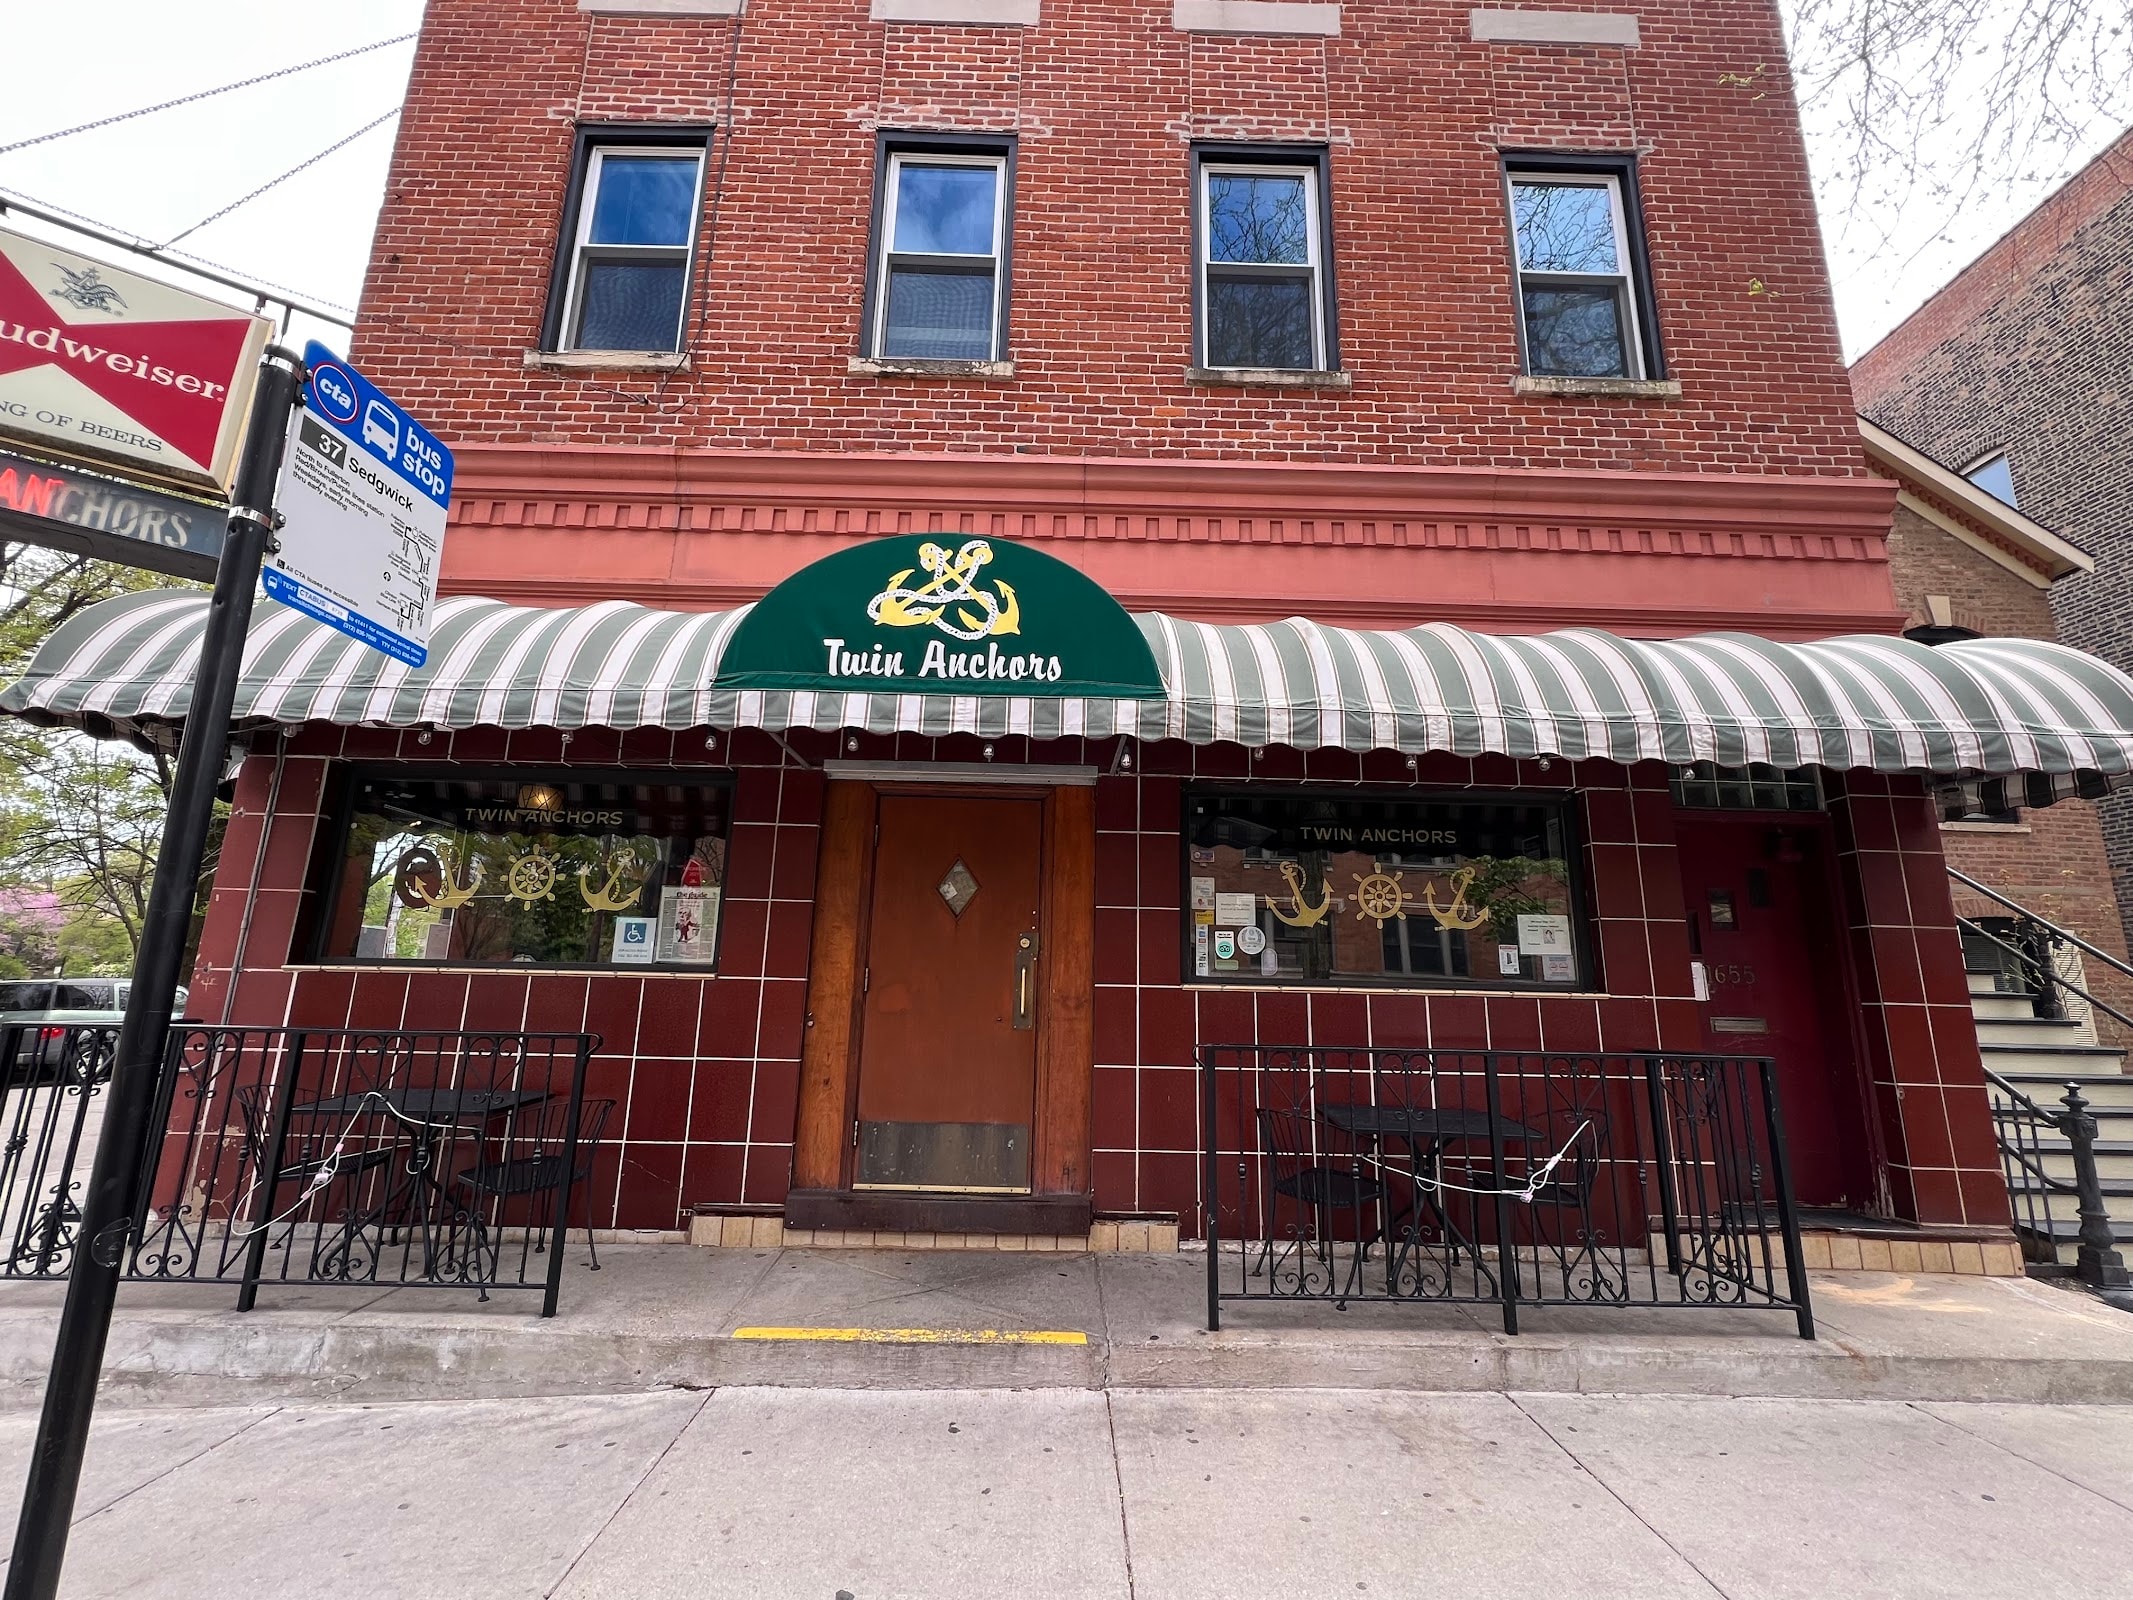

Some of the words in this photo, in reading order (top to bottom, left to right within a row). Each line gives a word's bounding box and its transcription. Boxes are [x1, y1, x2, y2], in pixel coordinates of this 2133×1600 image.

[319, 378, 352, 410] cta
[36, 410, 73, 428] OF
[78, 420, 162, 452] BEERS
[296, 446, 315, 464] North
[316, 460, 323, 469] to
[405, 426, 442, 471] bus
[318, 433, 343, 460] 37
[348, 456, 413, 513] Sedgwick
[402, 452, 446, 496] stop
[0, 467, 192, 548] ANCHORS
[344, 497, 369, 518] morning
[366, 502, 385, 518] station
[294, 569, 306, 580] CTA
[281, 580, 297, 593] TEXT
[299, 588, 326, 607] CTABUS
[823, 638, 905, 678] Twin
[917, 639, 1062, 682] Anchors
[464, 807, 518, 823] TWIN
[524, 809, 623, 826] ANCHORS
[1299, 826, 1356, 842] TWIN
[1360, 828, 1457, 844] ANCHORS
